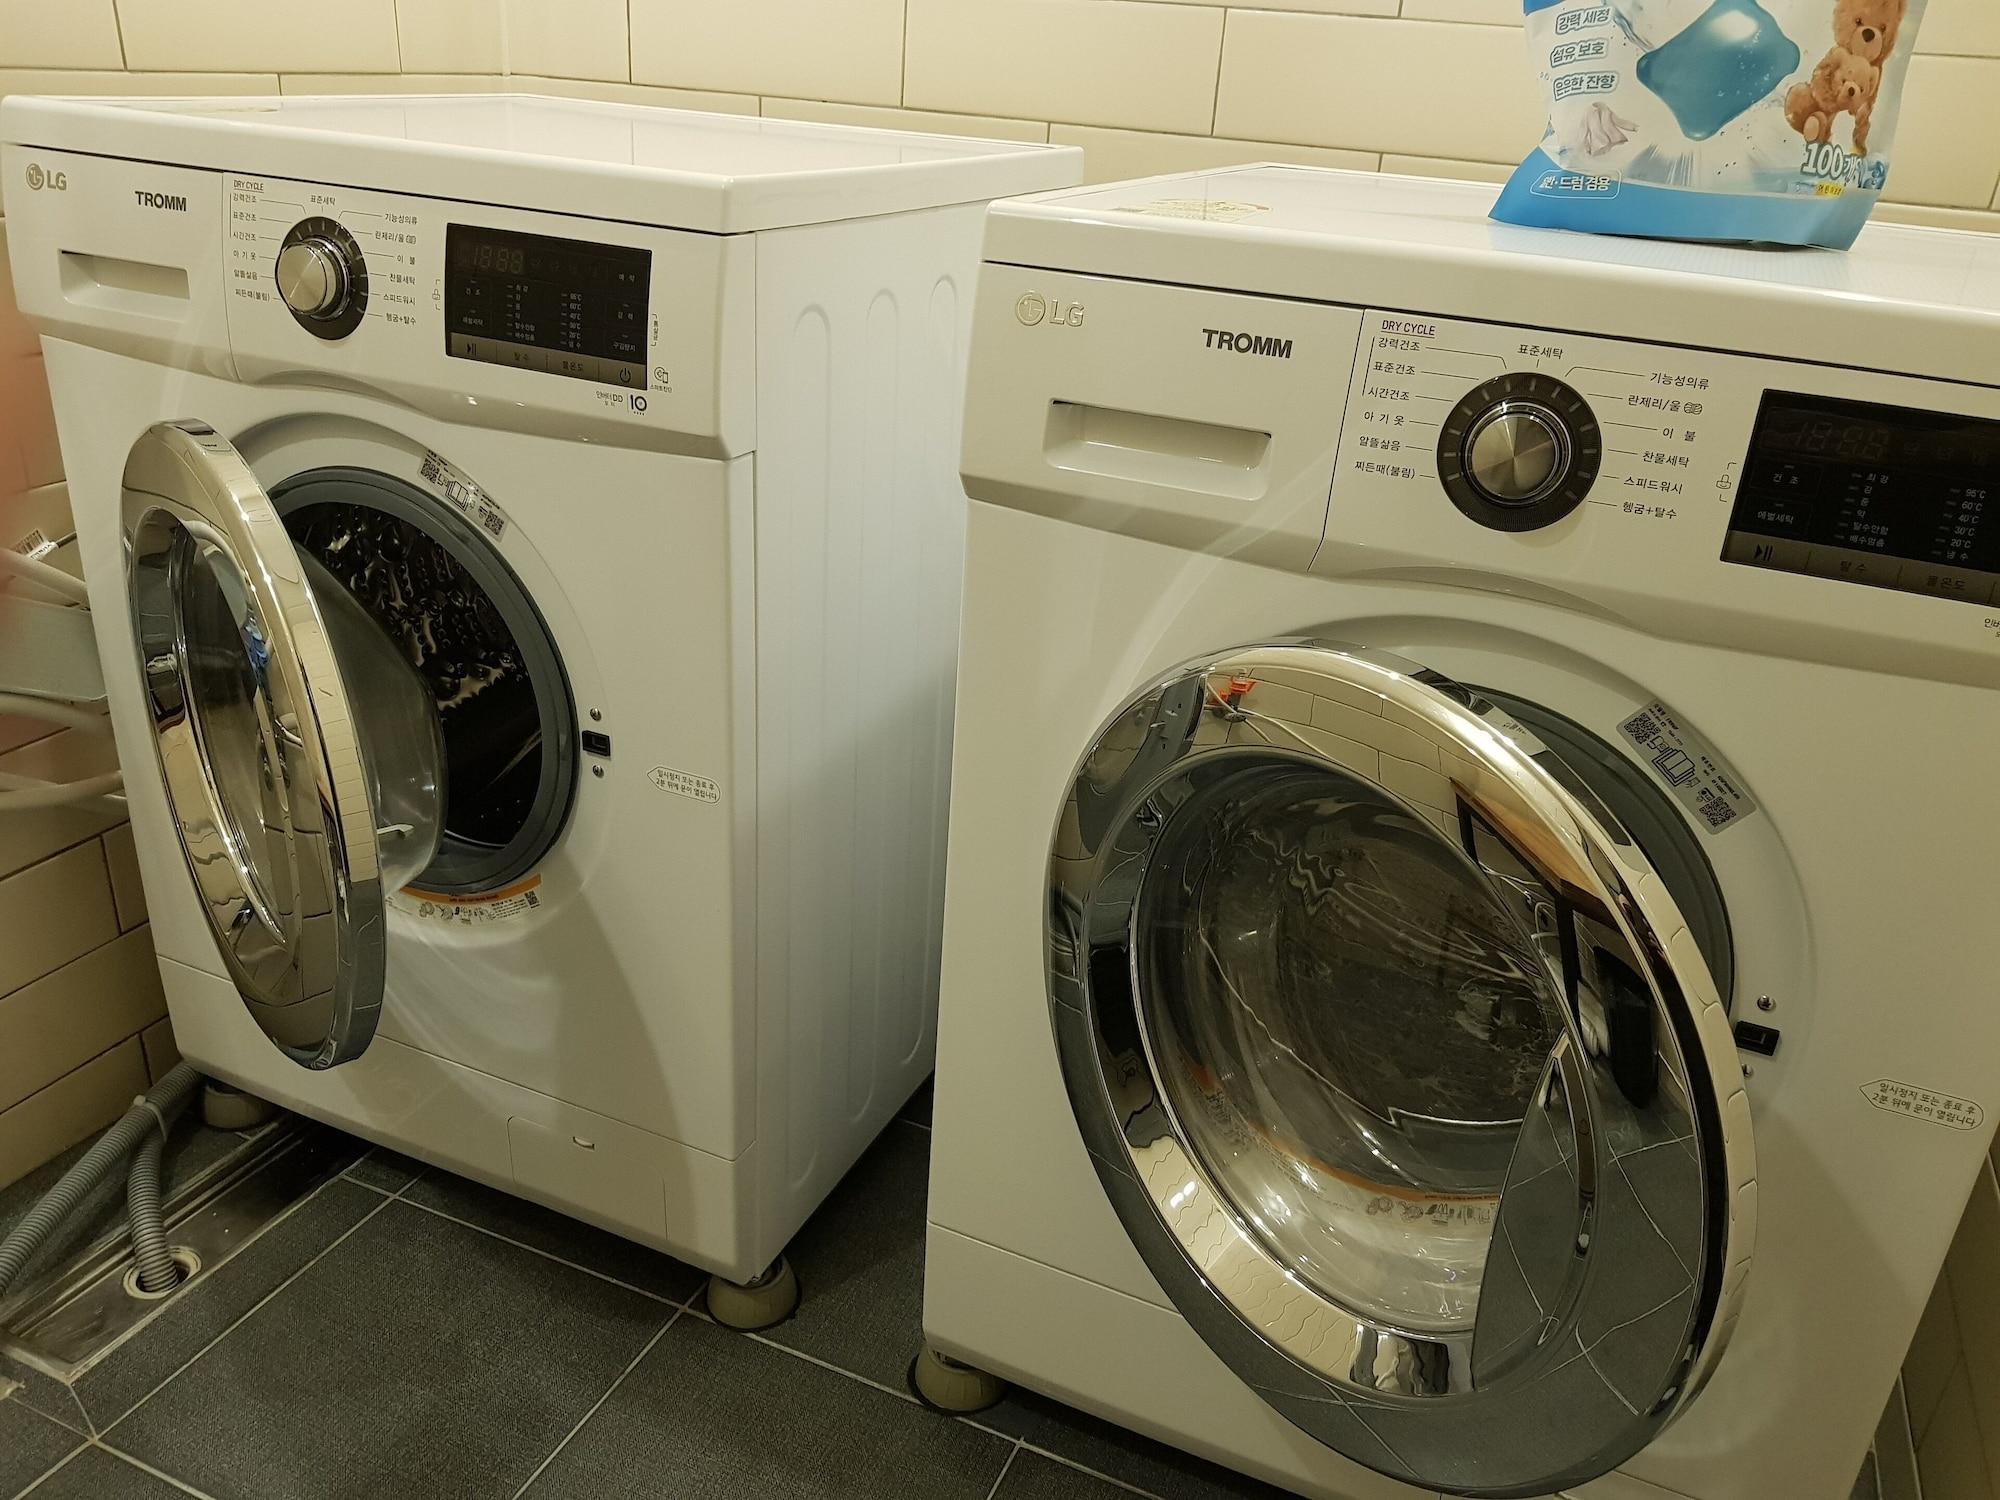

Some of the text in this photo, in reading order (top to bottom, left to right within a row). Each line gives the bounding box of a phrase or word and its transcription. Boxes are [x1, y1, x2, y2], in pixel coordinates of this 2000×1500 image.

[1559, 8, 1610, 31] 강력 세정
[1553, 41, 1605, 63] 섬유 보호
[1556, 75, 1616, 96] 은은한 잔향
[46, 170, 67, 191] LG
[233, 180, 246, 190] DRY
[1585, 176, 1611, 191] 겸용
[134, 191, 187, 212] TROMM
[310, 194, 336, 206] 표준세탁
[233, 211, 257, 222] 표준건조
[233, 231, 257, 242] 시간건조
[389, 273, 416, 286] 찬물세탁
[383, 293, 416, 306] 스피드워시
[1049, 299, 1085, 327] LG
[1381, 319, 1436, 336] DRY CYCLE
[1202, 328, 1293, 359] TROMM
[1378, 337, 1421, 352] 강력건조
[1517, 344, 1563, 360] 표준세탁
[1372, 361, 1416, 375] 표준건조
[1649, 372, 1710, 390] 기능성의류
[1367, 386, 1410, 401] 시간건조
[630, 394, 647, 412] 10
[1627, 395, 1682, 413] 란제리/울
[1358, 435, 1402, 452] 알뜰삶음
[1642, 450, 1690, 469] 찬물세탁
[1354, 460, 1416, 480] 찌든때(불림)
[1623, 476, 1684, 495] 스피드워시
[1622, 501, 1677, 519] 헹굼+탈수
[1879, 1082, 1976, 1115] 일시정지 또는 종료 후
[1872, 1092, 1976, 1127] 2분 뒤에 문이 열립니다
